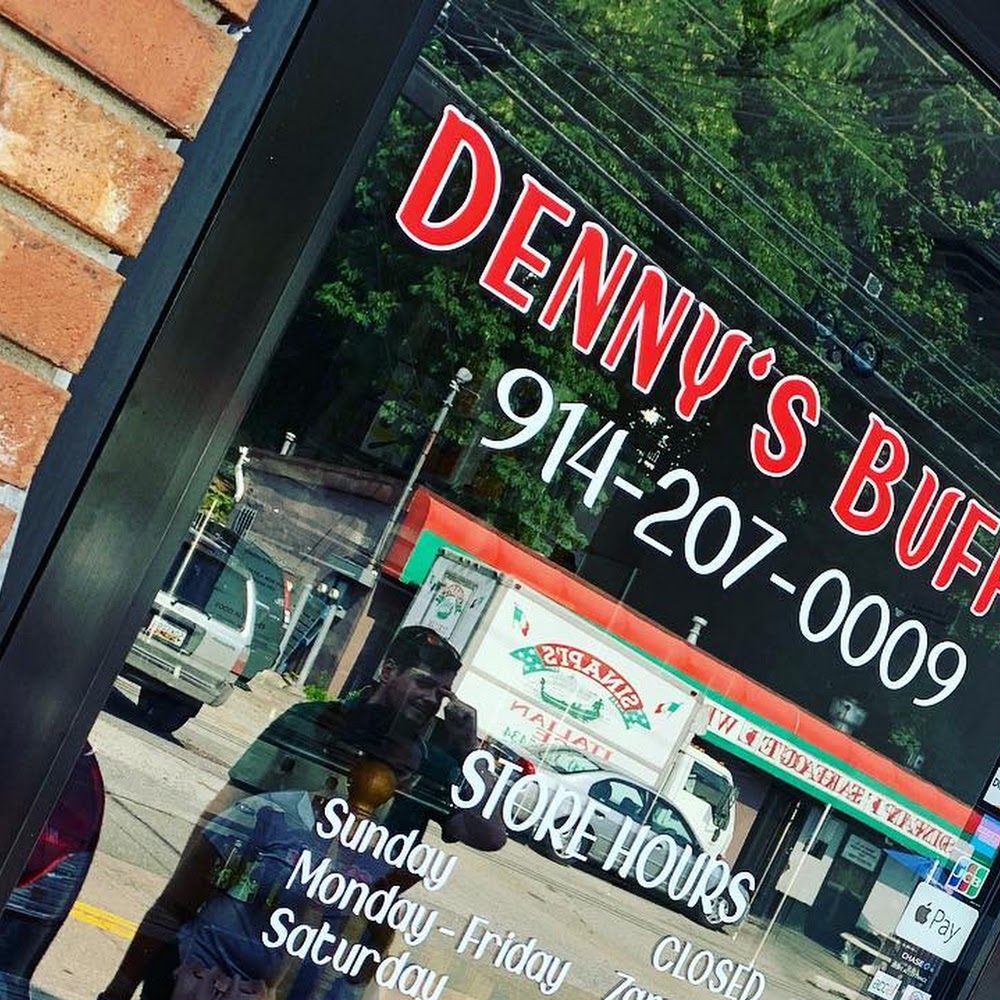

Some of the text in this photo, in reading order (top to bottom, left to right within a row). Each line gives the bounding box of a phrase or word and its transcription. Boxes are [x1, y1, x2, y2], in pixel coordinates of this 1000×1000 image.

[396, 104, 820, 478] DENNY'S
[480, 367, 967, 707] 914-207-0009
[315, 797, 458, 892] Sunday
[451, 750, 757, 927] STORE HOURS
[285, 849, 440, 947] Monday
[456, 914, 573, 996] Friday
[901, 951, 925, 969] CHASE
[929, 908, 961, 944] Pay
